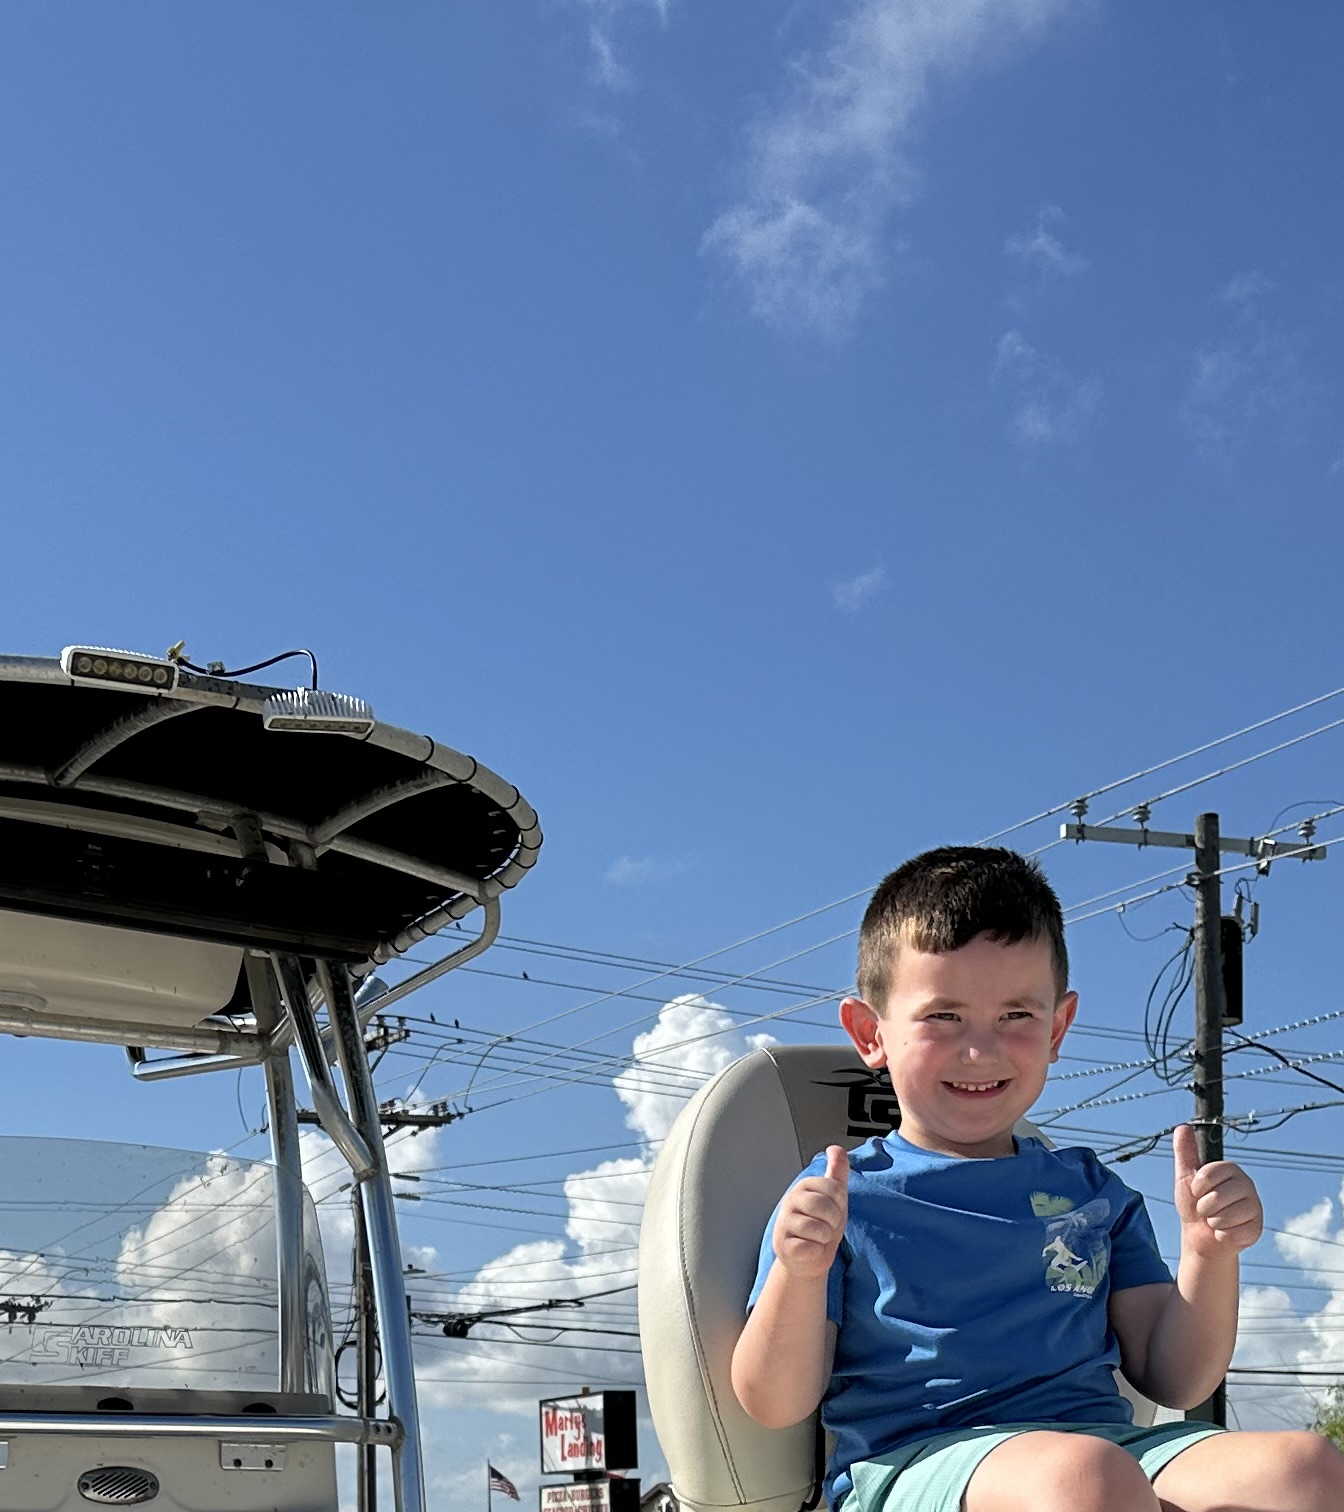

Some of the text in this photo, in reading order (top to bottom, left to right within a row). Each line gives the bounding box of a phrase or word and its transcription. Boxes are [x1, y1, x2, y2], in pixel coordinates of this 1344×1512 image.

[1050, 1283, 1072, 1292] LOS
[31, 1325, 194, 1353] CAROLINA
[560, 1433, 603, 1463] Landing
